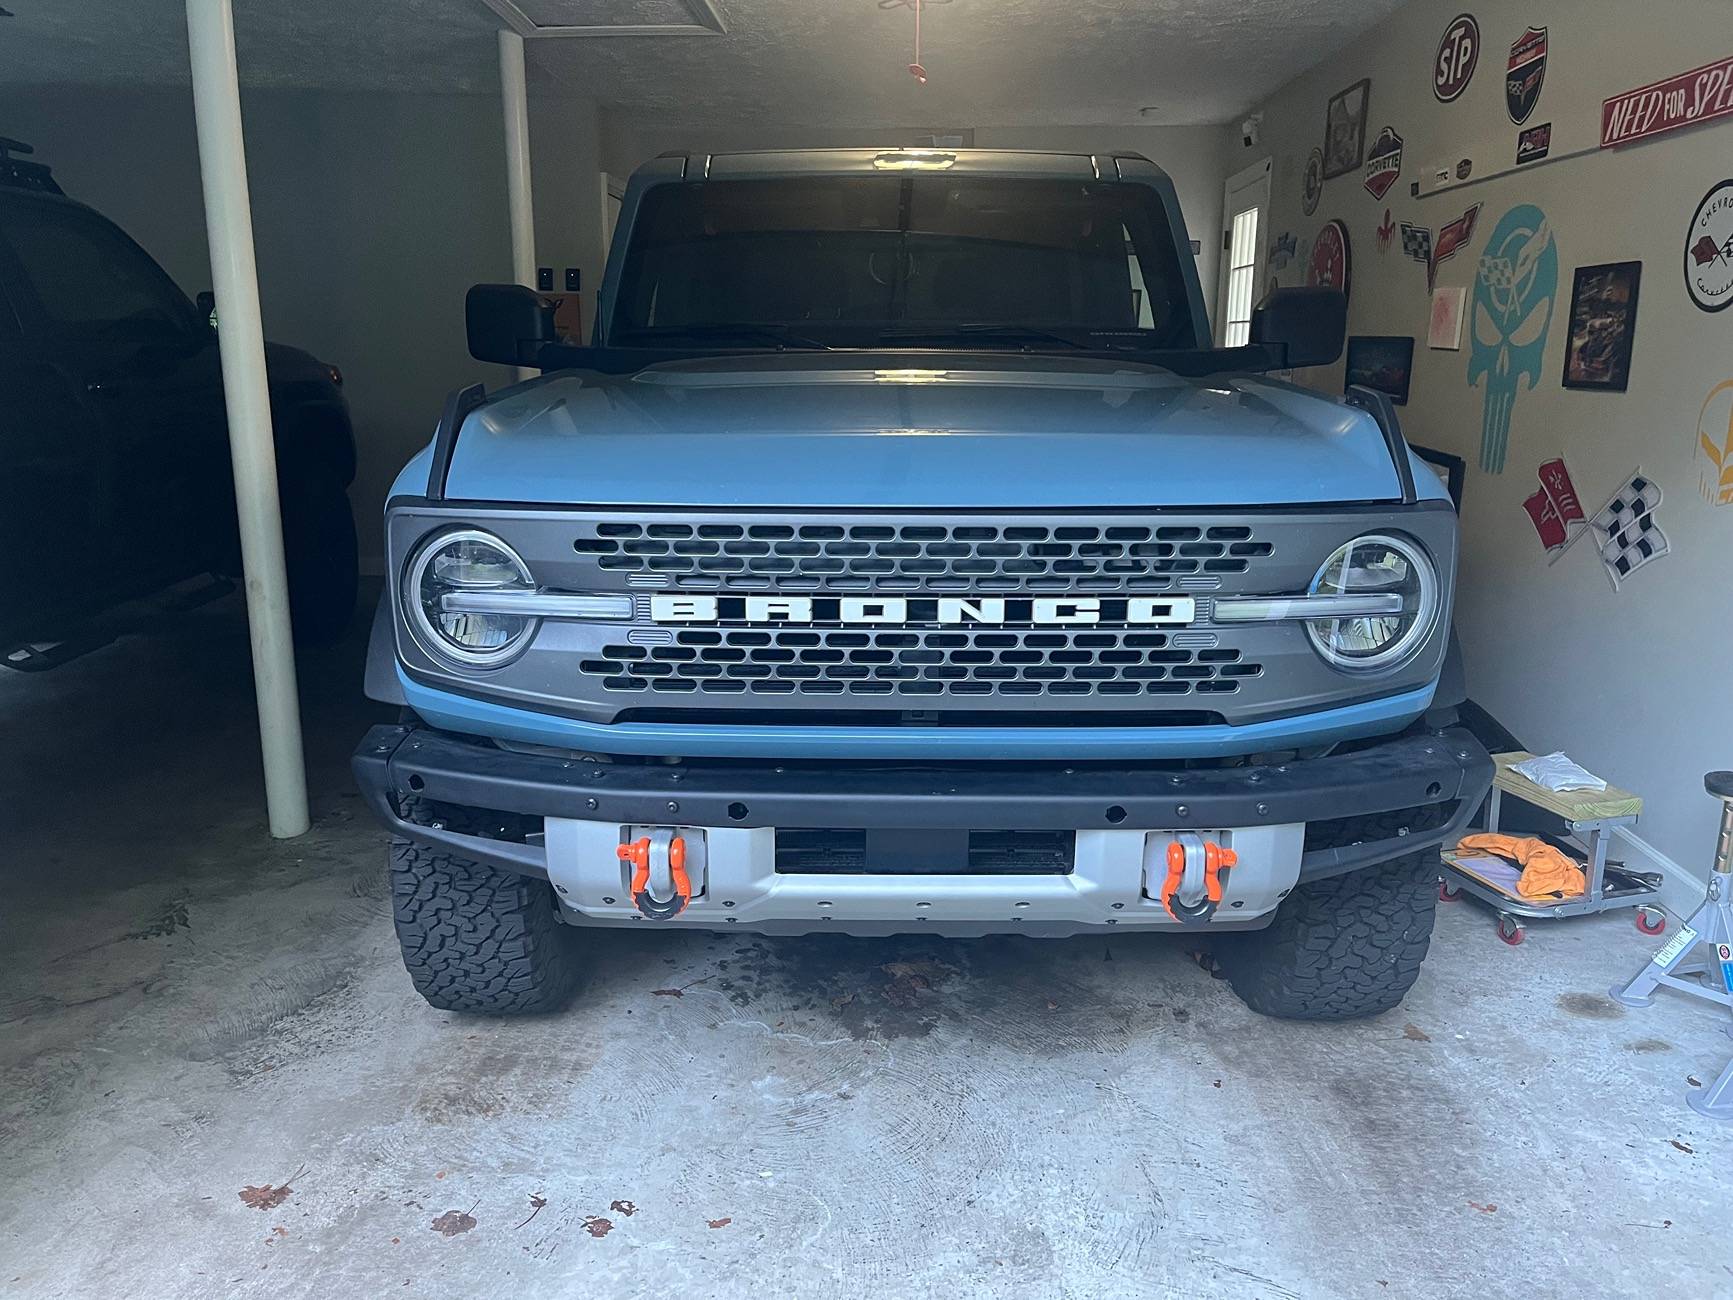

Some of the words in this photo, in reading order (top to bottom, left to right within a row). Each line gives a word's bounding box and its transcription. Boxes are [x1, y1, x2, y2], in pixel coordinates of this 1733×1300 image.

[1437, 27, 1472, 86] STP
[1604, 91, 1663, 142] NEED
[1664, 88, 1685, 121] FOR
[1686, 64, 1733, 118] SPE
[1366, 152, 1400, 178] CORVETTE
[651, 596, 1195, 623] BRONCO
